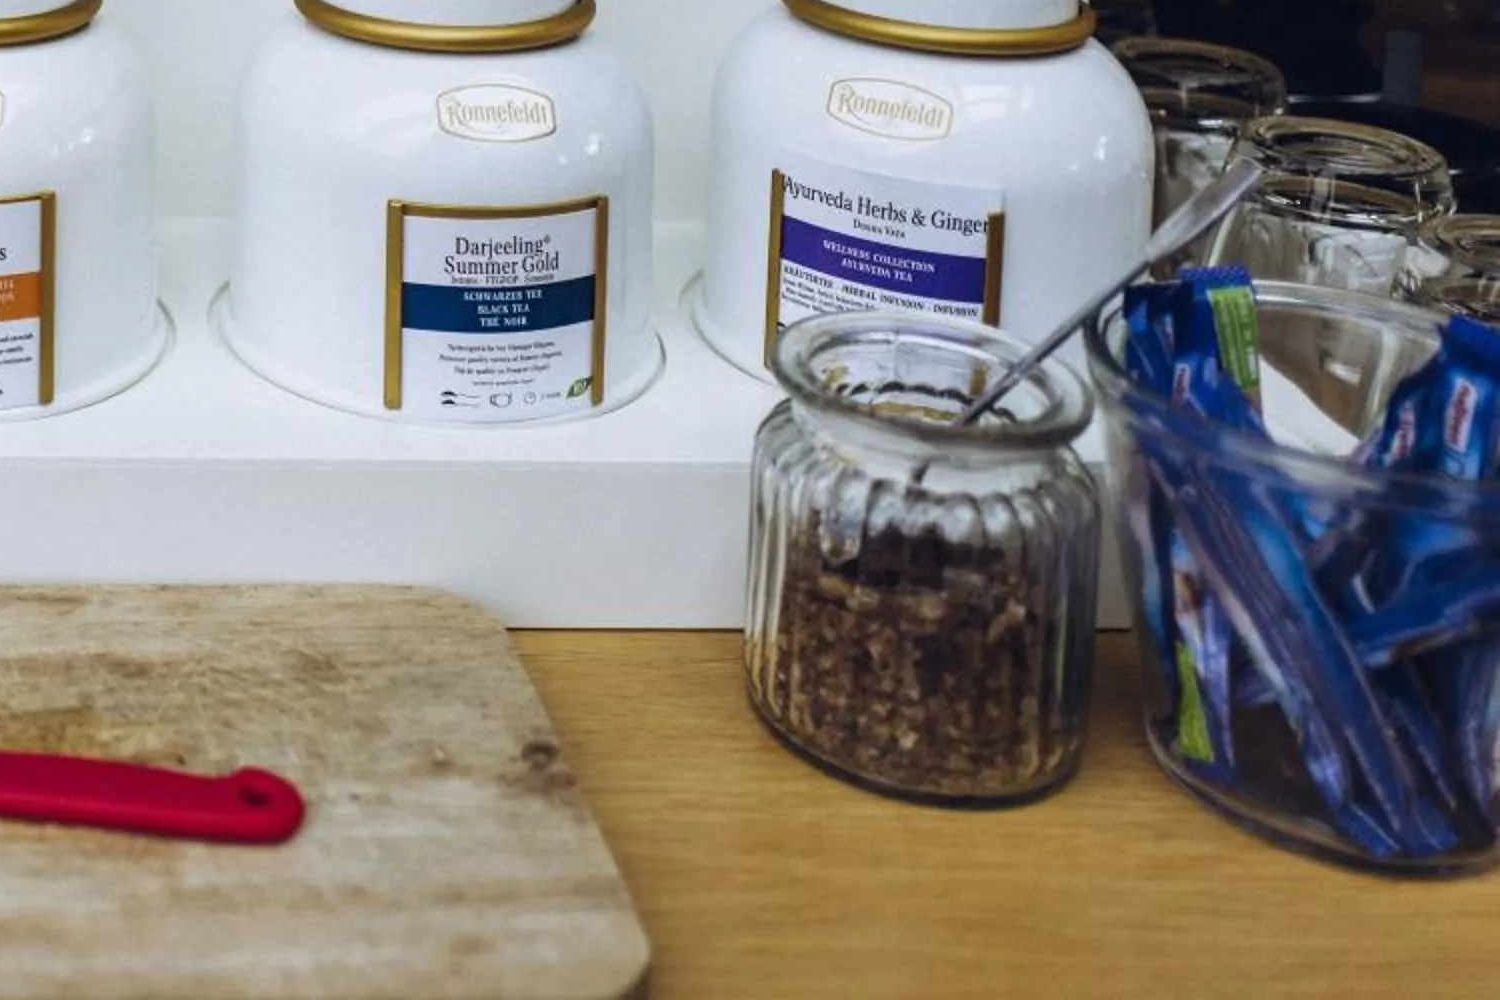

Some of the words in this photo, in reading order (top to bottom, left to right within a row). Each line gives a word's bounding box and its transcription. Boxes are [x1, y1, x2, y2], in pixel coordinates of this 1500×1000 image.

[447, 99, 548, 134] Ronnefeldt
[838, 84, 946, 131] Ronnefeldt
[782, 176, 853, 212] Ayurveda
[856, 195, 907, 224] Herbs
[911, 208, 927, 226] &
[930, 210, 989, 237] Ginger
[443, 255, 519, 275] Summer
[521, 251, 560, 273] Gold
[822, 239, 871, 261] WELLNESS
[873, 252, 936, 273] COLLECTION
[894, 270, 914, 283] TEA
[476, 303, 509, 315] BLACK
[511, 303, 531, 313] TEA
[503, 316, 528, 327] NOIR
